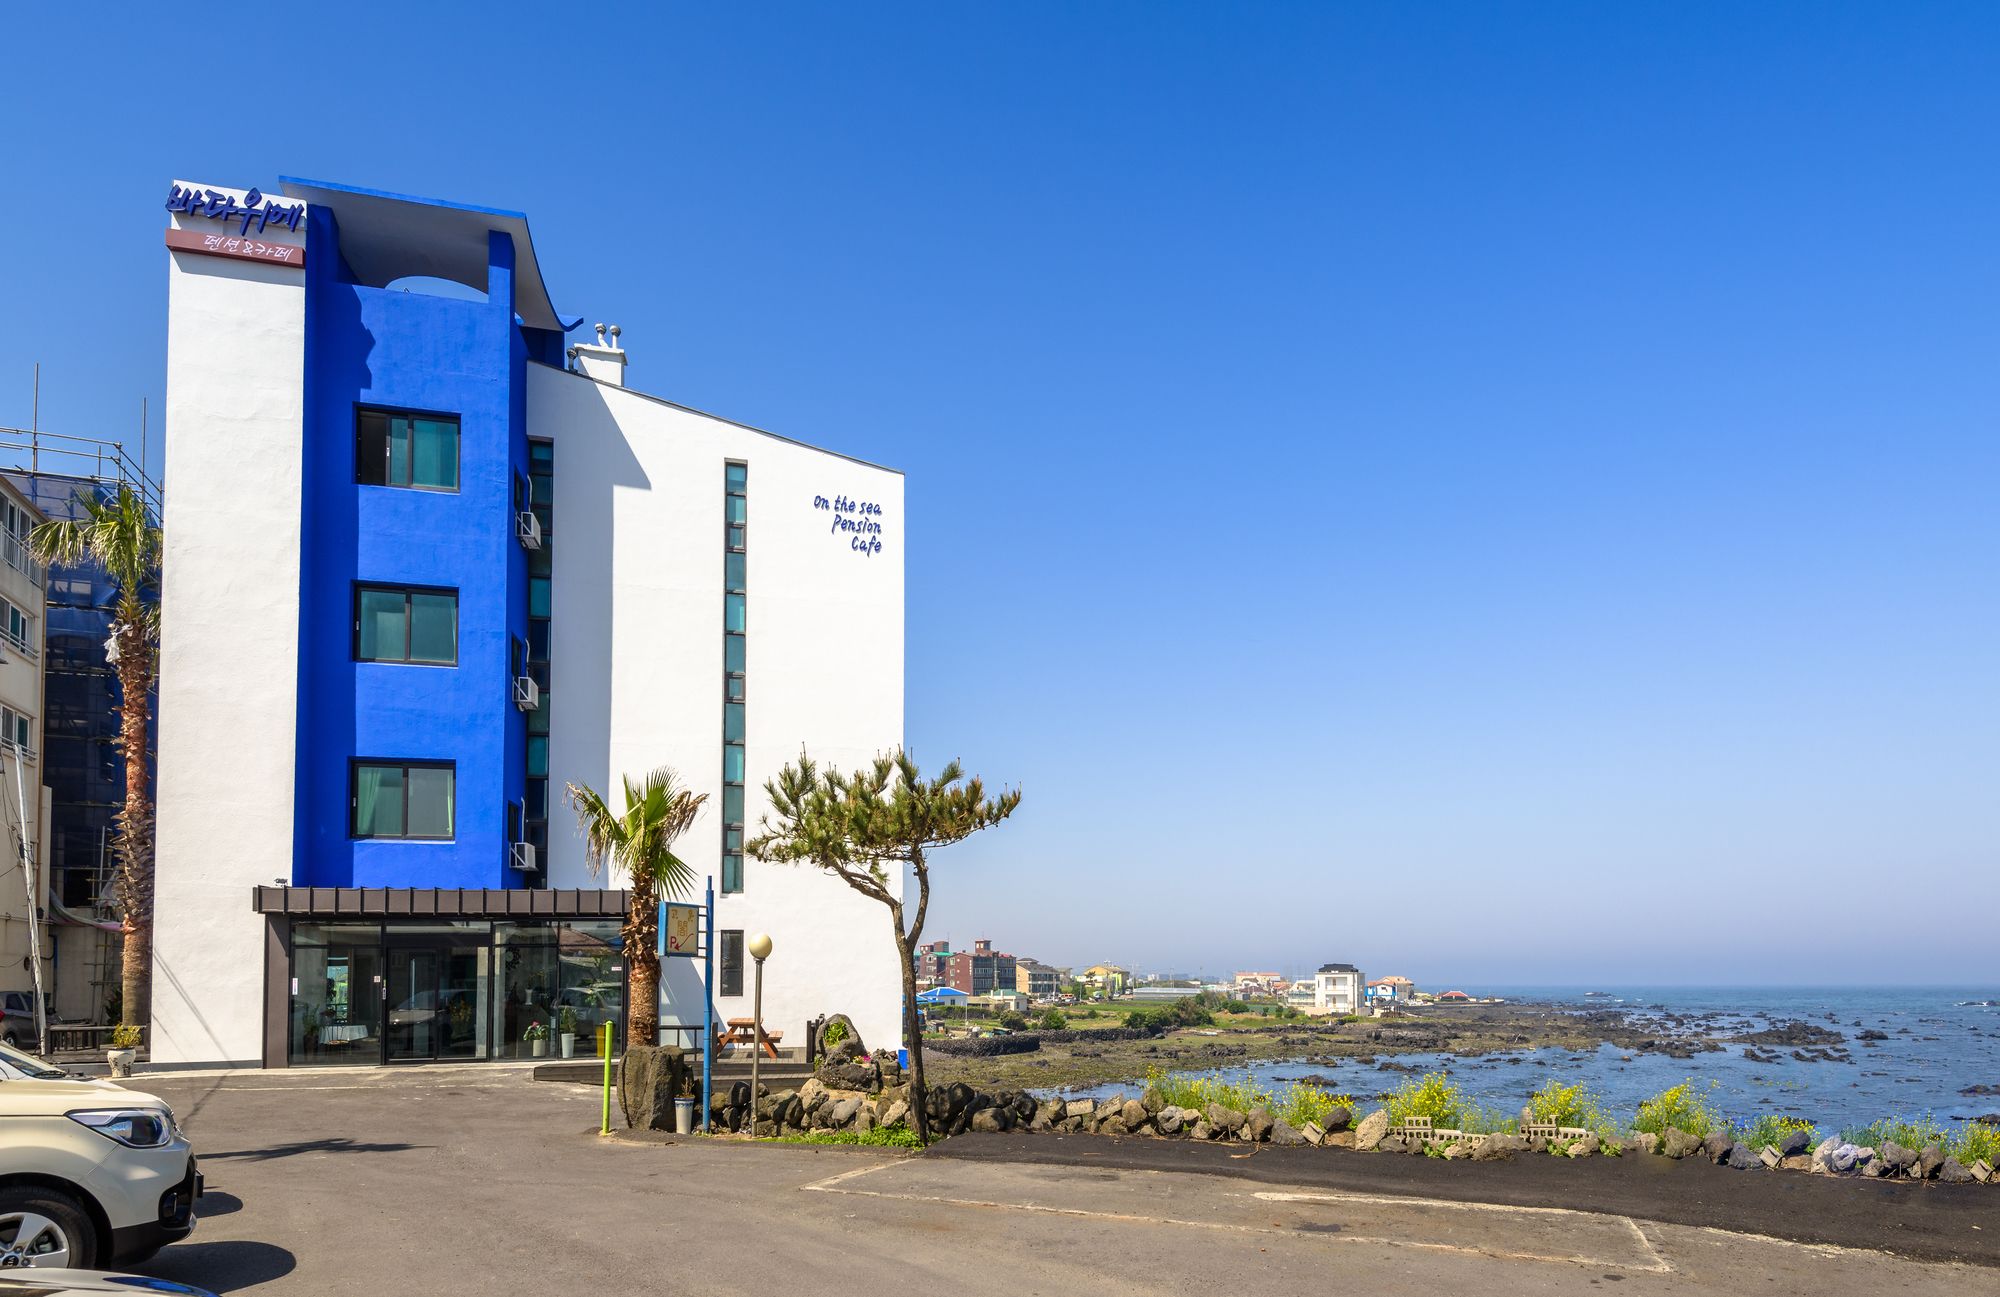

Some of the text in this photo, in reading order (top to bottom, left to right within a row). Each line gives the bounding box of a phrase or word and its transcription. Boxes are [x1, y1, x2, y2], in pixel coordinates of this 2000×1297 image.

[834, 495, 856, 513] the
[859, 502, 882, 516] sea
[851, 535, 882, 558] Cafe
[670, 936, 677, 948] P
